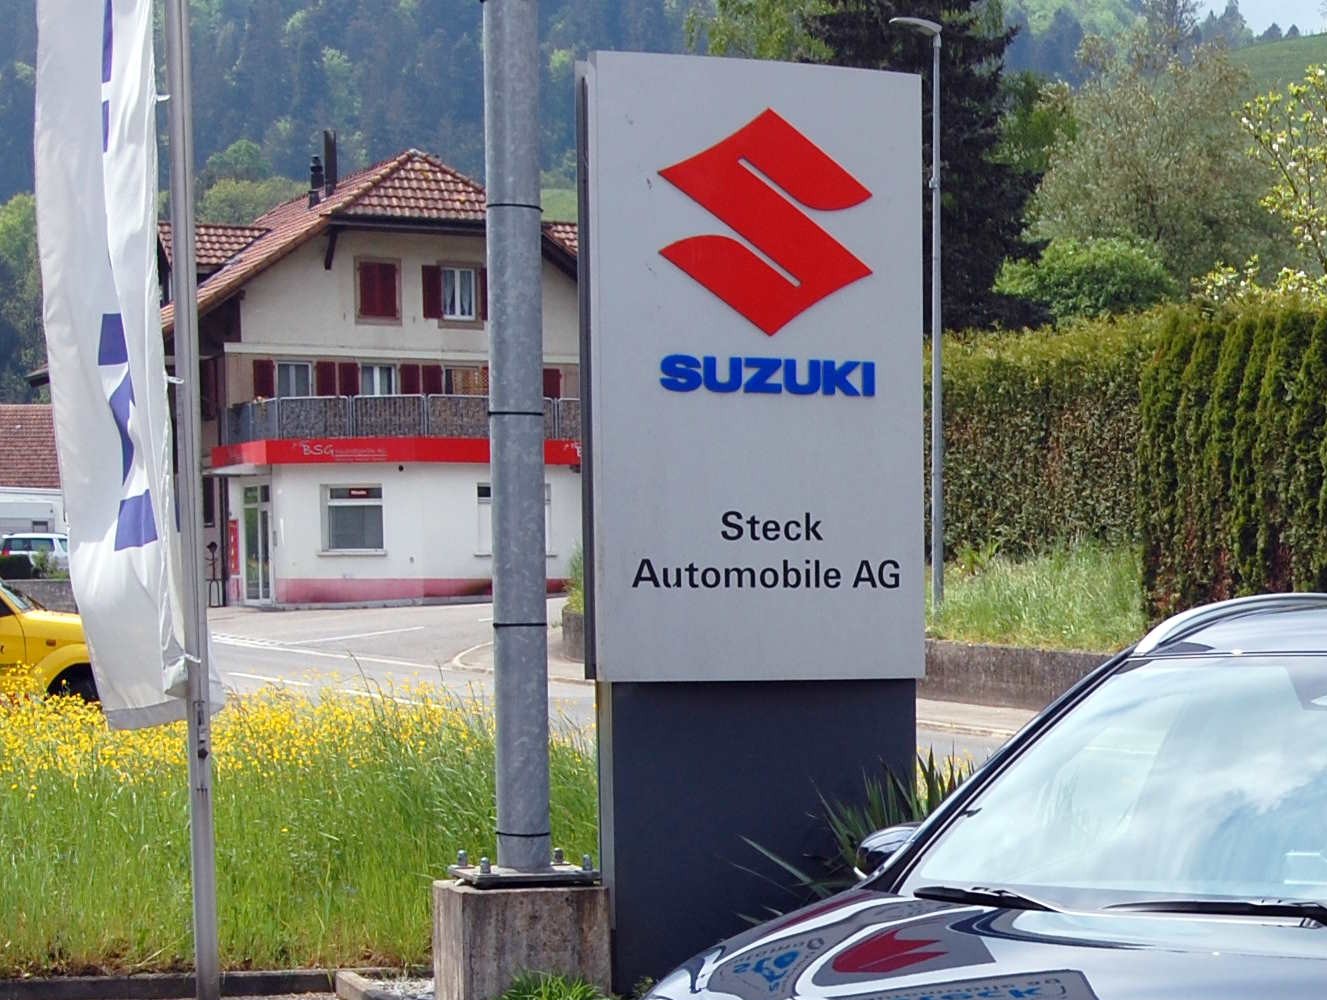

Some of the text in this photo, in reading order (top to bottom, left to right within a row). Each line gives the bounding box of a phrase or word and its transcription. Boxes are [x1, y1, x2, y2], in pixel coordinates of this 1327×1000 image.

[659, 353, 876, 397] SUZUKI
[720, 511, 823, 541] Steck
[632, 559, 900, 589] Automobile AG
